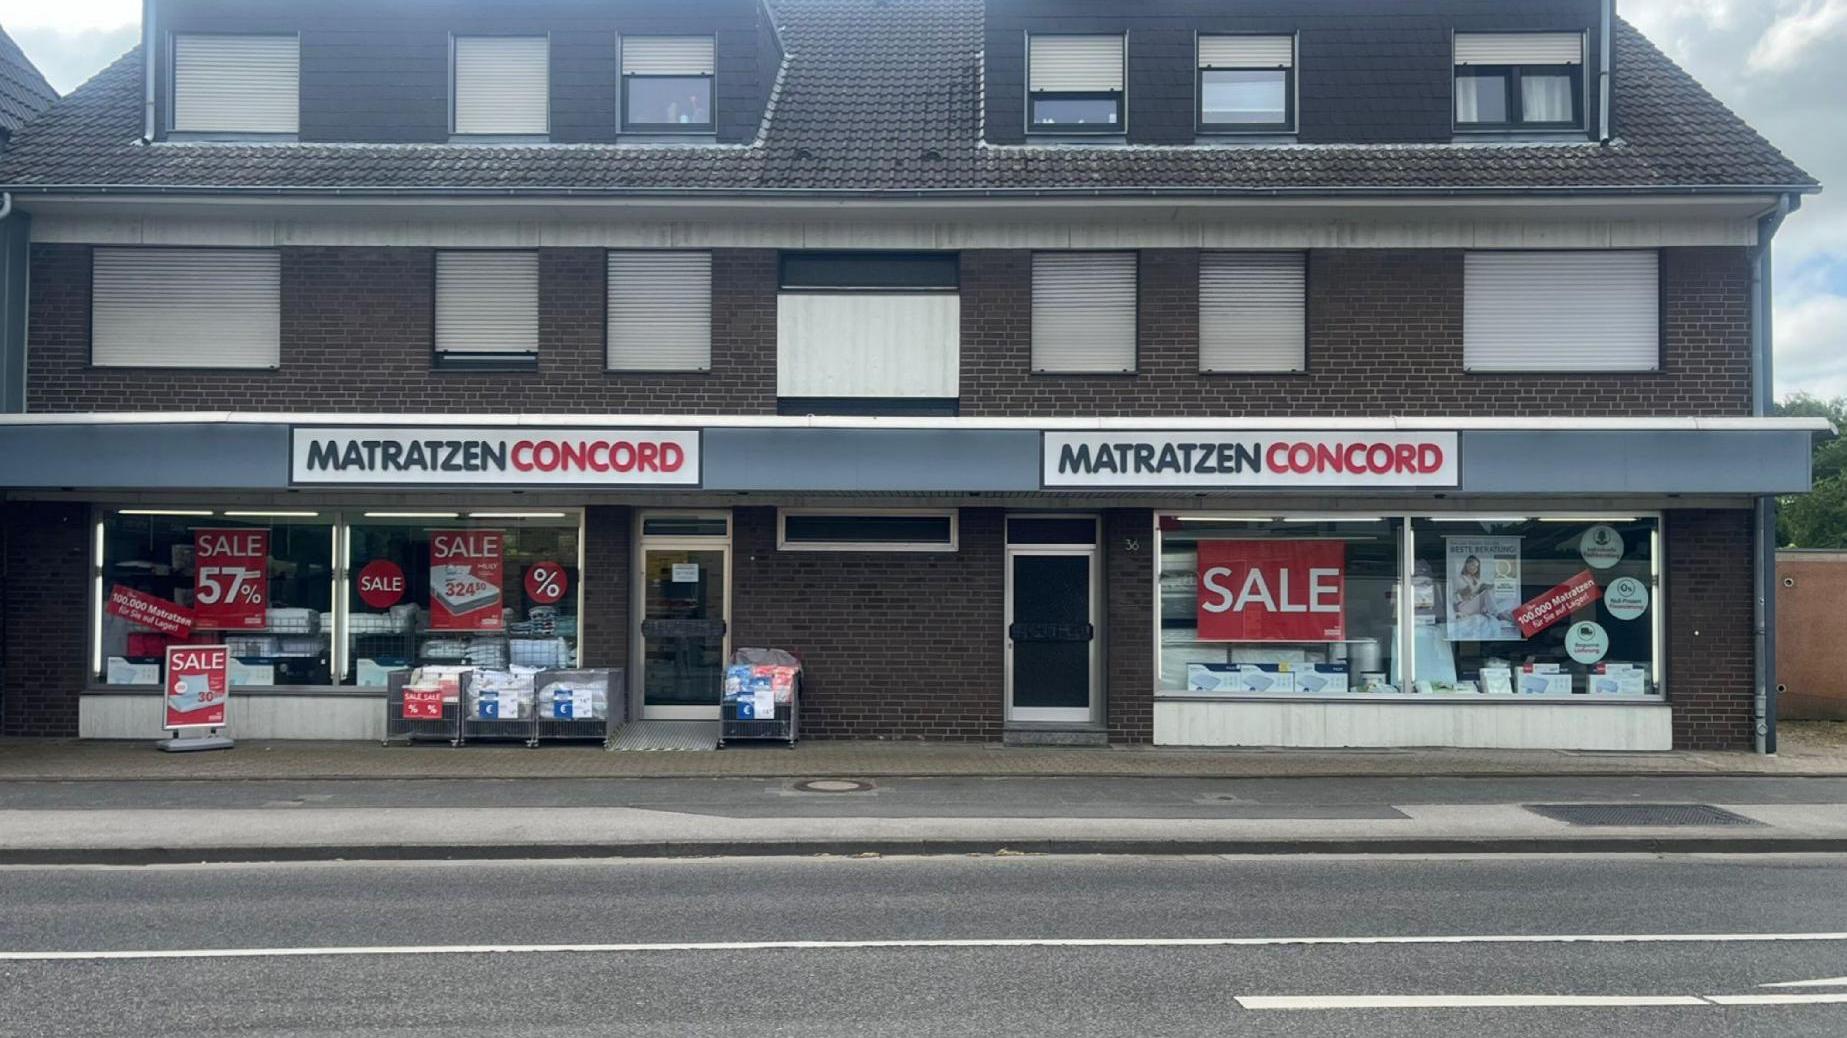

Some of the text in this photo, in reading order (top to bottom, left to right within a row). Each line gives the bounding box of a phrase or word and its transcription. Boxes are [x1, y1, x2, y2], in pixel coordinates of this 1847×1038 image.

[306, 440, 684, 473] MATRATZEN CONCORD
[1058, 442, 1444, 474] MATRATZEN CONCORD
[198, 535, 262, 557] SALE
[434, 536, 499, 558] SALE
[197, 566, 262, 604] 57%
[361, 576, 403, 592] SALE
[533, 568, 560, 597] %
[1202, 566, 1341, 613] SALE
[112, 591, 148, 611] 100.000
[147, 604, 192, 627] Matratzen
[130, 609, 142, 619] Sie
[1518, 579, 1595, 625] 100.000 Matratzen
[171, 652, 225, 671] SALE
[404, 692, 441, 701] SALE SALE
